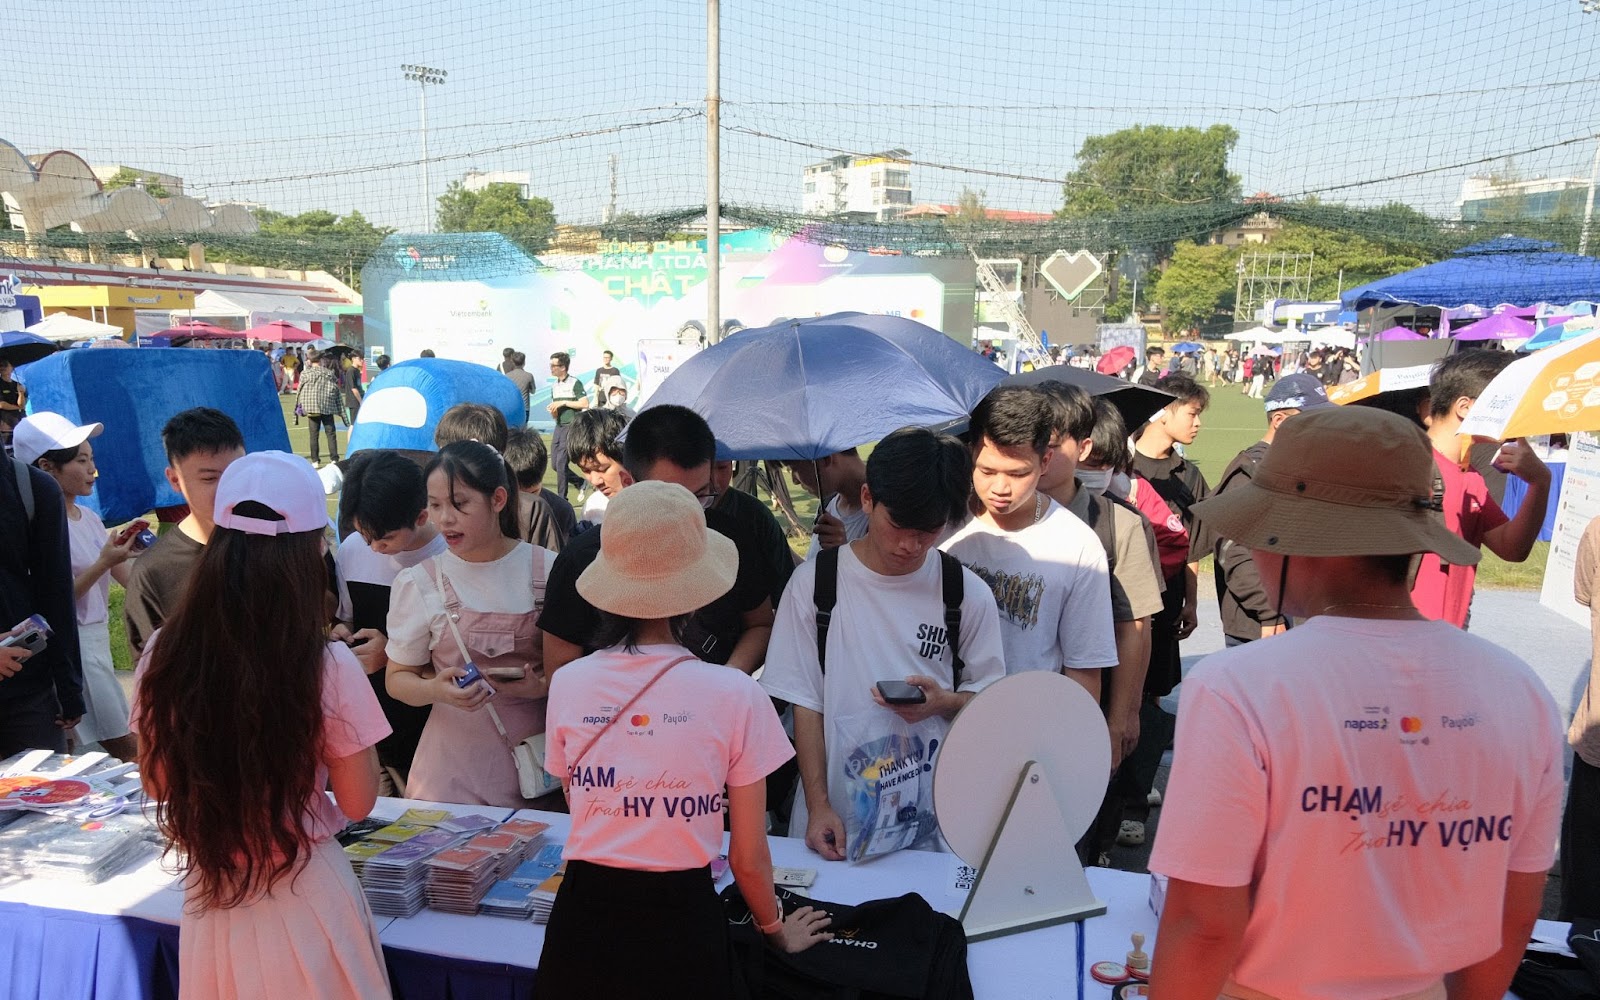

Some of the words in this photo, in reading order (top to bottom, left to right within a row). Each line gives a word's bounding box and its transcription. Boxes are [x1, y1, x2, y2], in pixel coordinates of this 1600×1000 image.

[916, 622, 950, 646] SHU
[918, 641, 945, 661] UP!
[583, 714, 613, 726] napas
[663, 713, 688, 725] Payoo
[879, 756, 909, 779] THANK
[645, 769, 692, 791] chia
[880, 777, 897, 791] HAVE
[902, 769, 915, 782] NICE
[623, 796, 655, 818] HY
[663, 793, 722, 823] VỌNG
[1301, 785, 1383, 821] CHẠM
[1416, 789, 1473, 814] chia
[1386, 819, 1428, 847] HY
[1438, 814, 1513, 852] VỌNG
